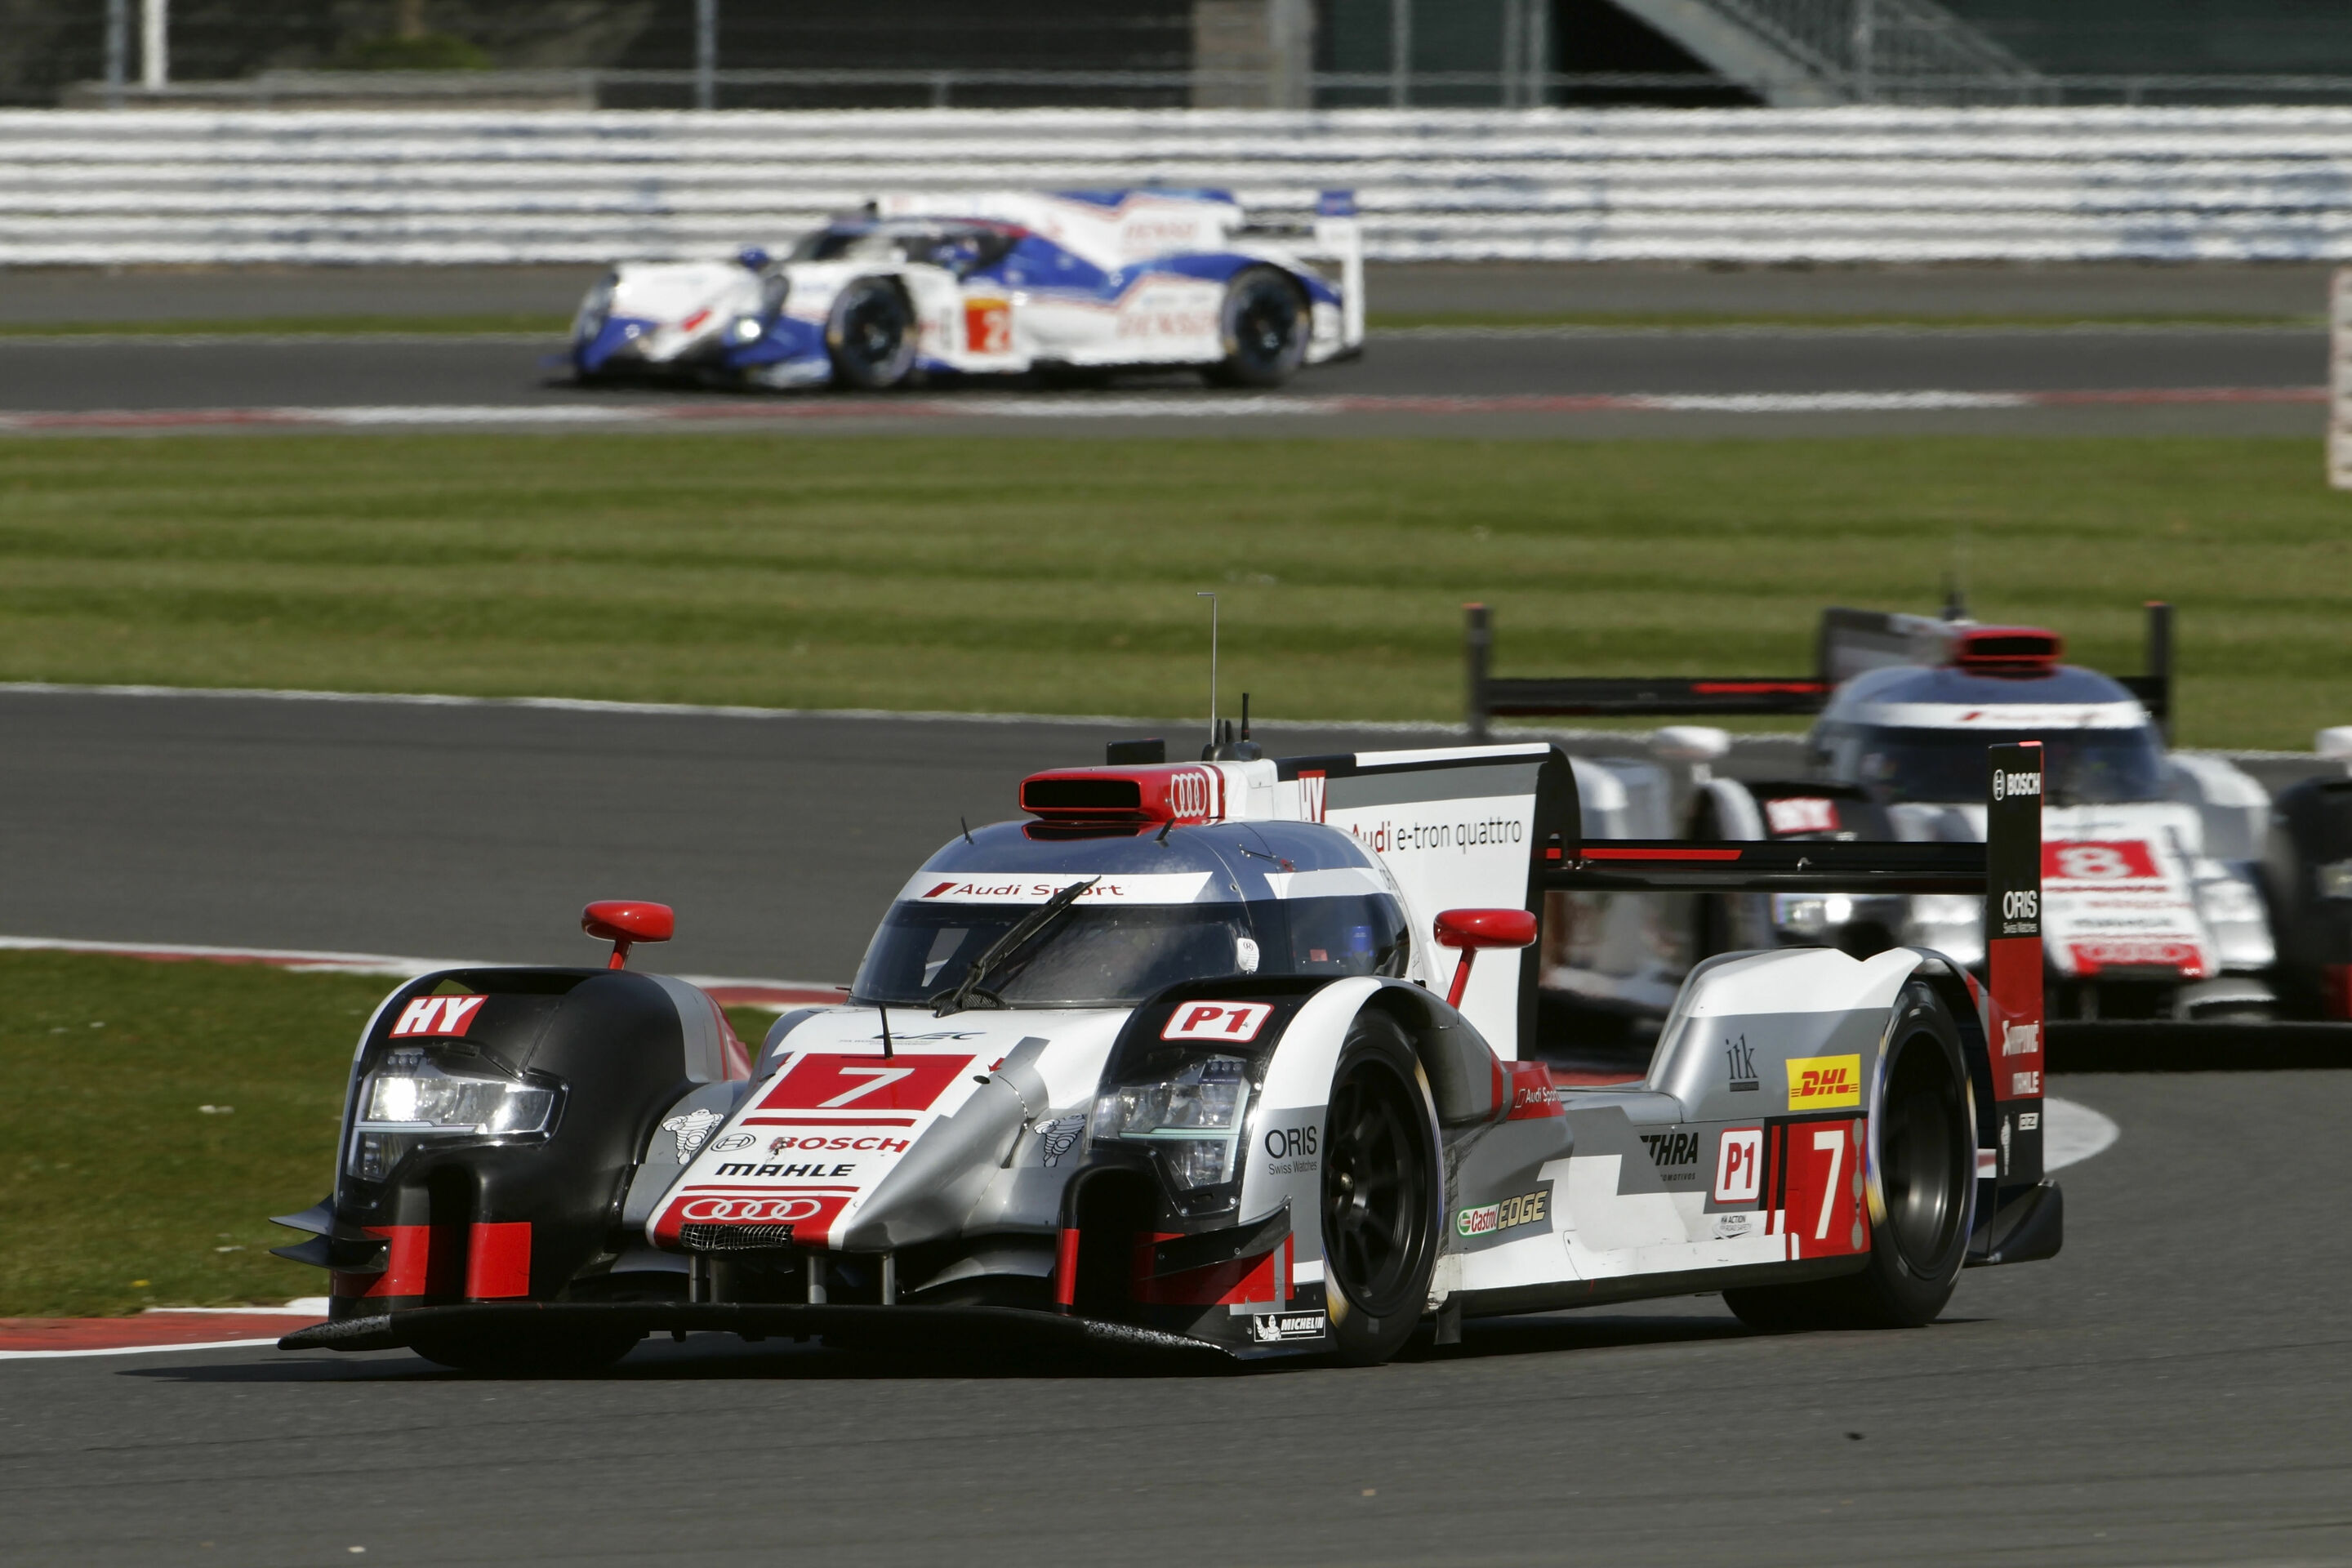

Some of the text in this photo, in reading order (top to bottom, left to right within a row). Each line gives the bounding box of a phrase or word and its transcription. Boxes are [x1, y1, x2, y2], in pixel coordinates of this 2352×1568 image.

[2007, 773, 2041, 795] BOSCH
[1397, 822, 1450, 851] e-tron
[1456, 817, 1521, 854] quattro
[2056, 846, 2133, 880] 8
[953, 884, 1022, 896] Audi
[2003, 890, 2038, 920] ORIS
[394, 997, 483, 1035] HY
[1180, 1007, 1252, 1033] P1
[1726, 1032, 1757, 1080] itk
[817, 1067, 915, 1107] 7
[1525, 1087, 1542, 1104] Audi
[1800, 1068, 1849, 1097] DHL
[769, 1137, 910, 1153] BOSCH
[1264, 1125, 1317, 1159] ORIS
[715, 1163, 856, 1177] MAHLE
[1268, 1160, 1317, 1175] Swiss Watches
[1724, 1142, 1755, 1190] P1
[1813, 1130, 1844, 1240] 7
[1472, 1190, 1548, 1232] Castrol EDGE
[1281, 1316, 1324, 1331] MICHELIN
